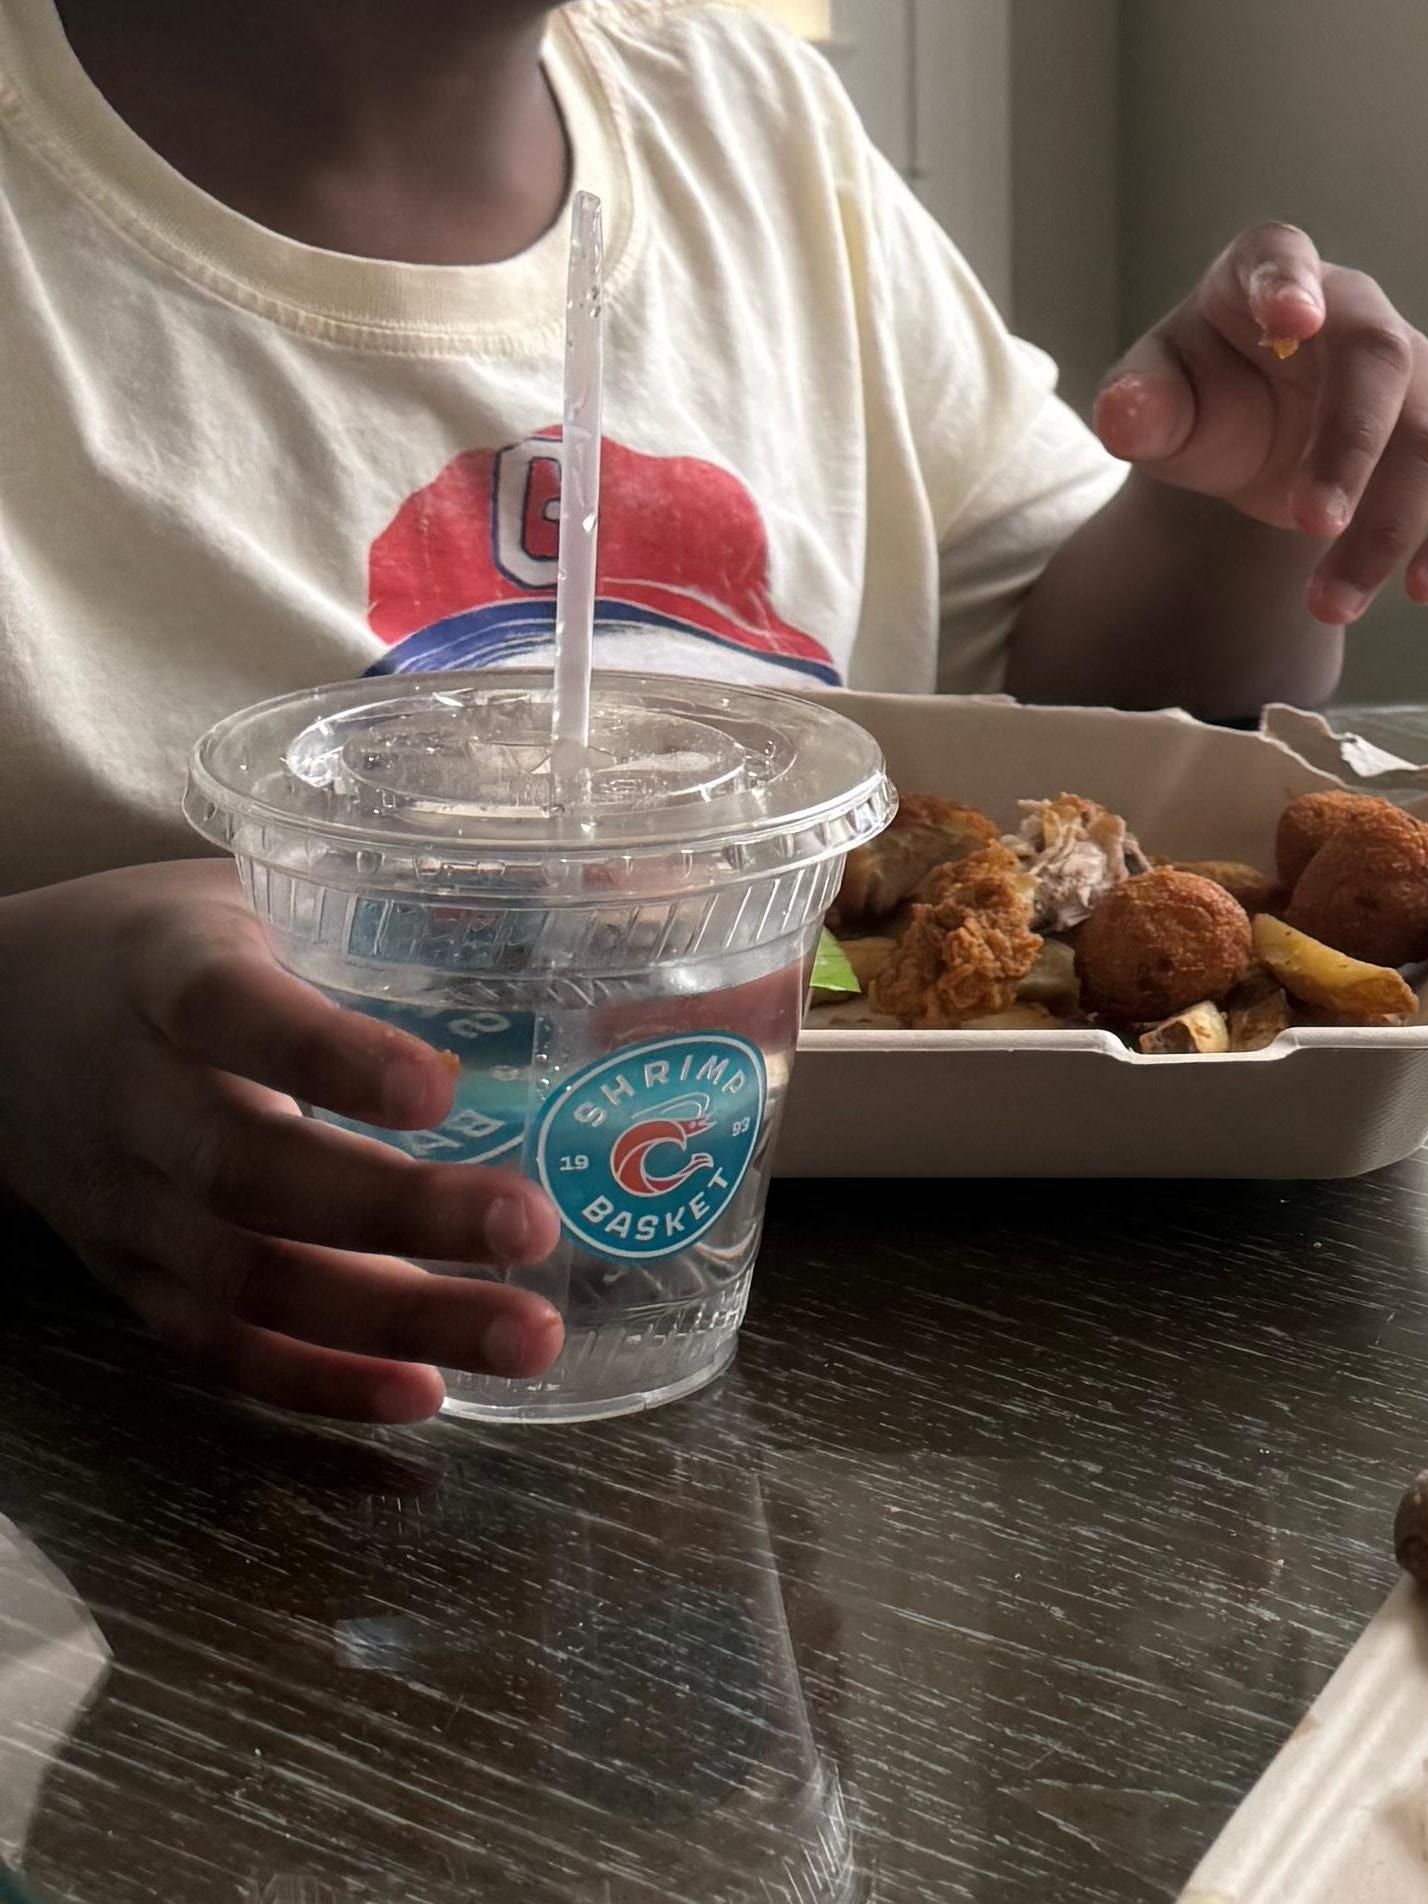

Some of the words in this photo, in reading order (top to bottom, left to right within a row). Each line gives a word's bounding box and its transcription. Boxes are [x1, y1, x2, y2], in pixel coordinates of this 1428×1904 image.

[573, 1054, 747, 1128] SHRIMP
[559, 1154, 590, 1172] 19
[731, 1116, 751, 1137] 93
[581, 1166, 729, 1241] BASKET
